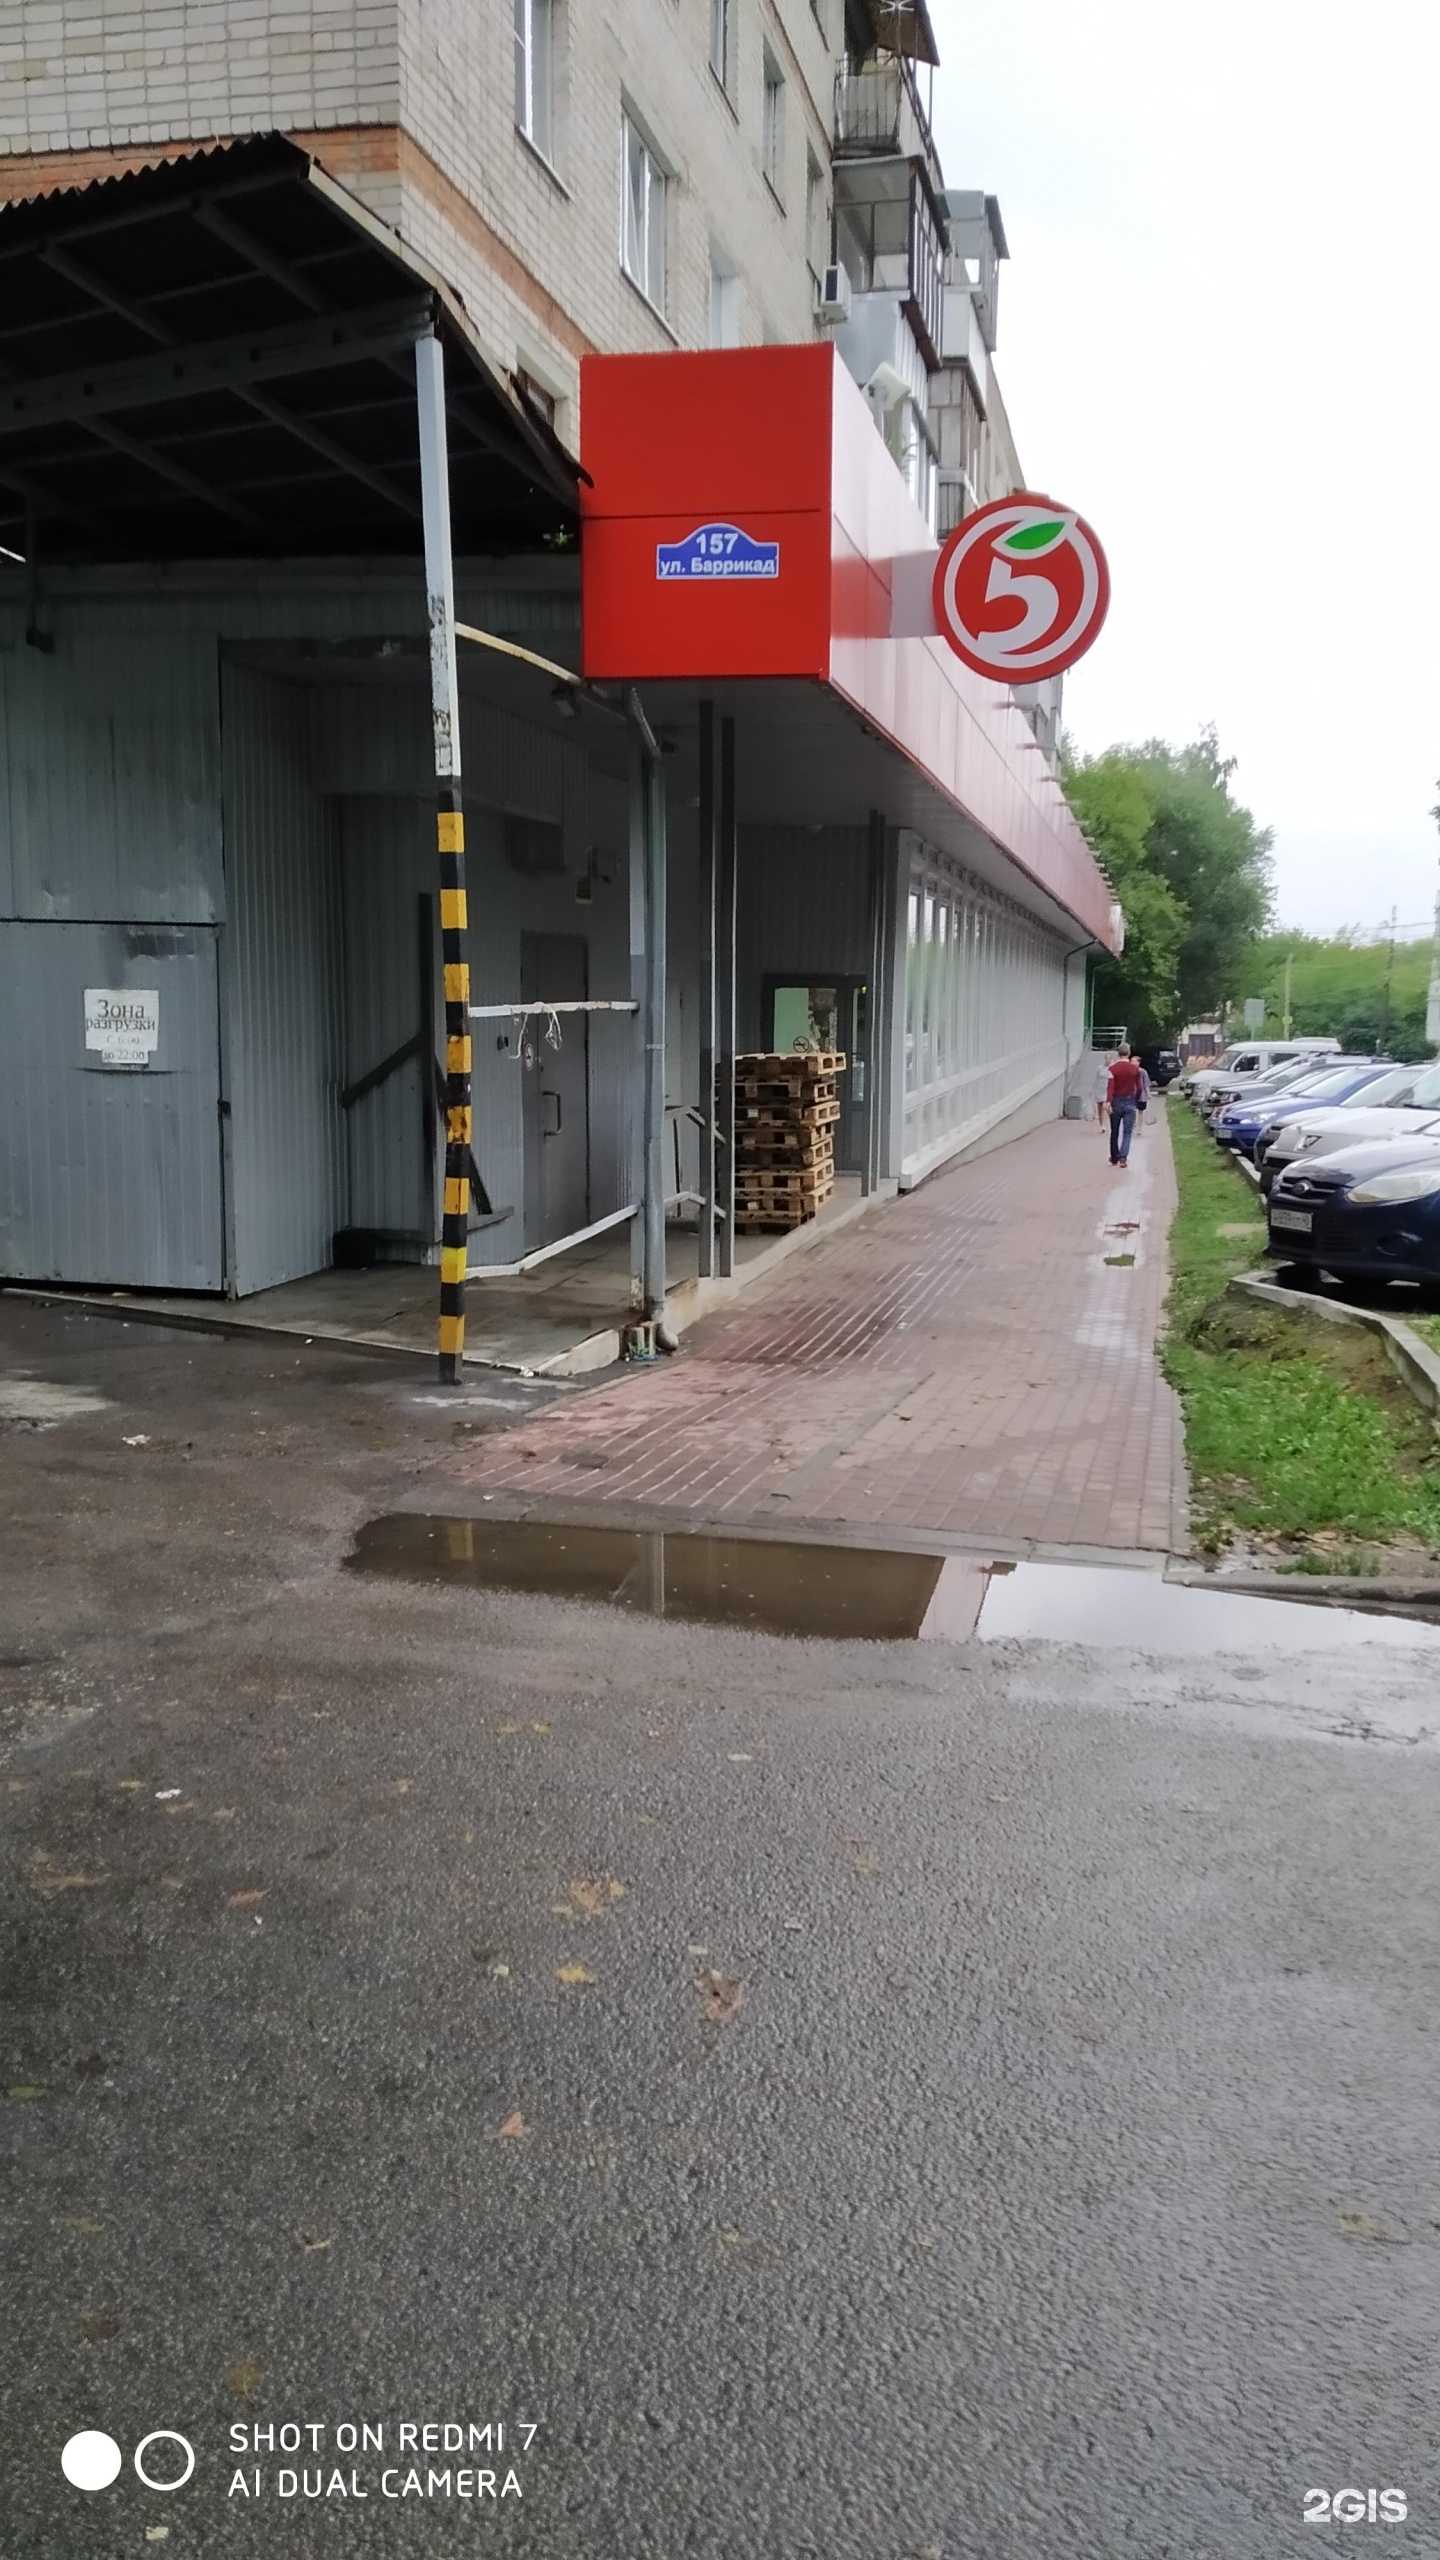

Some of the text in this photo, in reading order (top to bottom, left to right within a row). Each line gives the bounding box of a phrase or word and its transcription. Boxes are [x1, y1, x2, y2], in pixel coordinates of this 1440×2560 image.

[696, 533, 739, 554] 157
[660, 557, 775, 575] ул. Баррикад
[977, 556, 1060, 653] 5
[97, 999, 145, 1019] Зона
[86, 1018, 156, 1032] разгрузки
